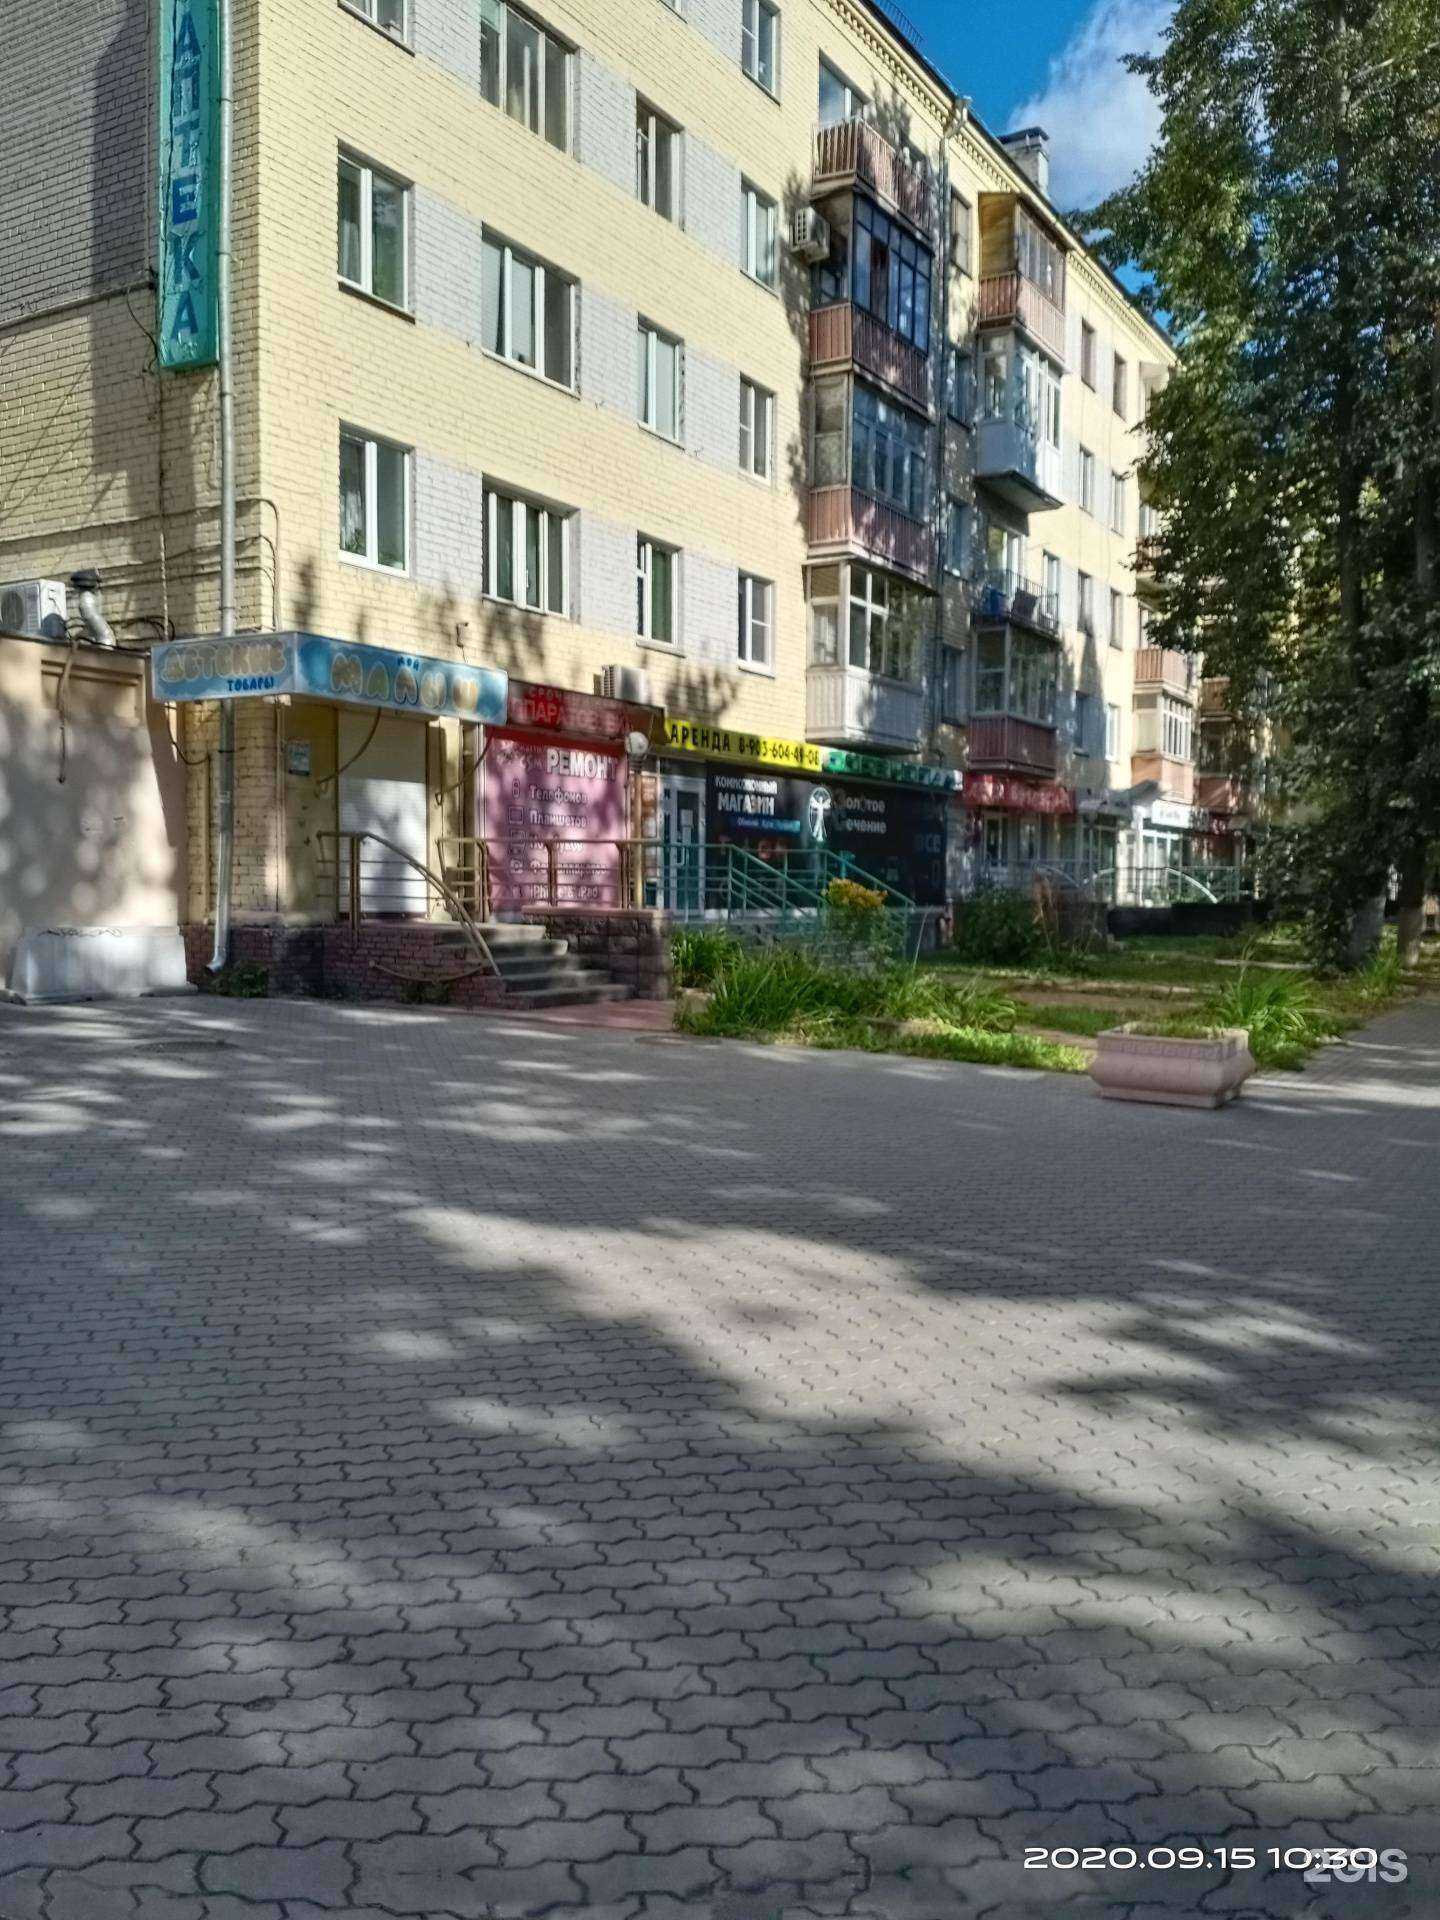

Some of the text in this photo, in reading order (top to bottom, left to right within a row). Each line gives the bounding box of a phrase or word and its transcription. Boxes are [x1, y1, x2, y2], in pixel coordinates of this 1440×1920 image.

[170, 12, 201, 340] АПТЕКА
[161, 638, 287, 682] ДЕТСКИЕ
[670, 723, 731, 752] АРЕНДА
[547, 747, 619, 782] РЕМОНТ
[717, 791, 775, 816] МАГАЗИН
